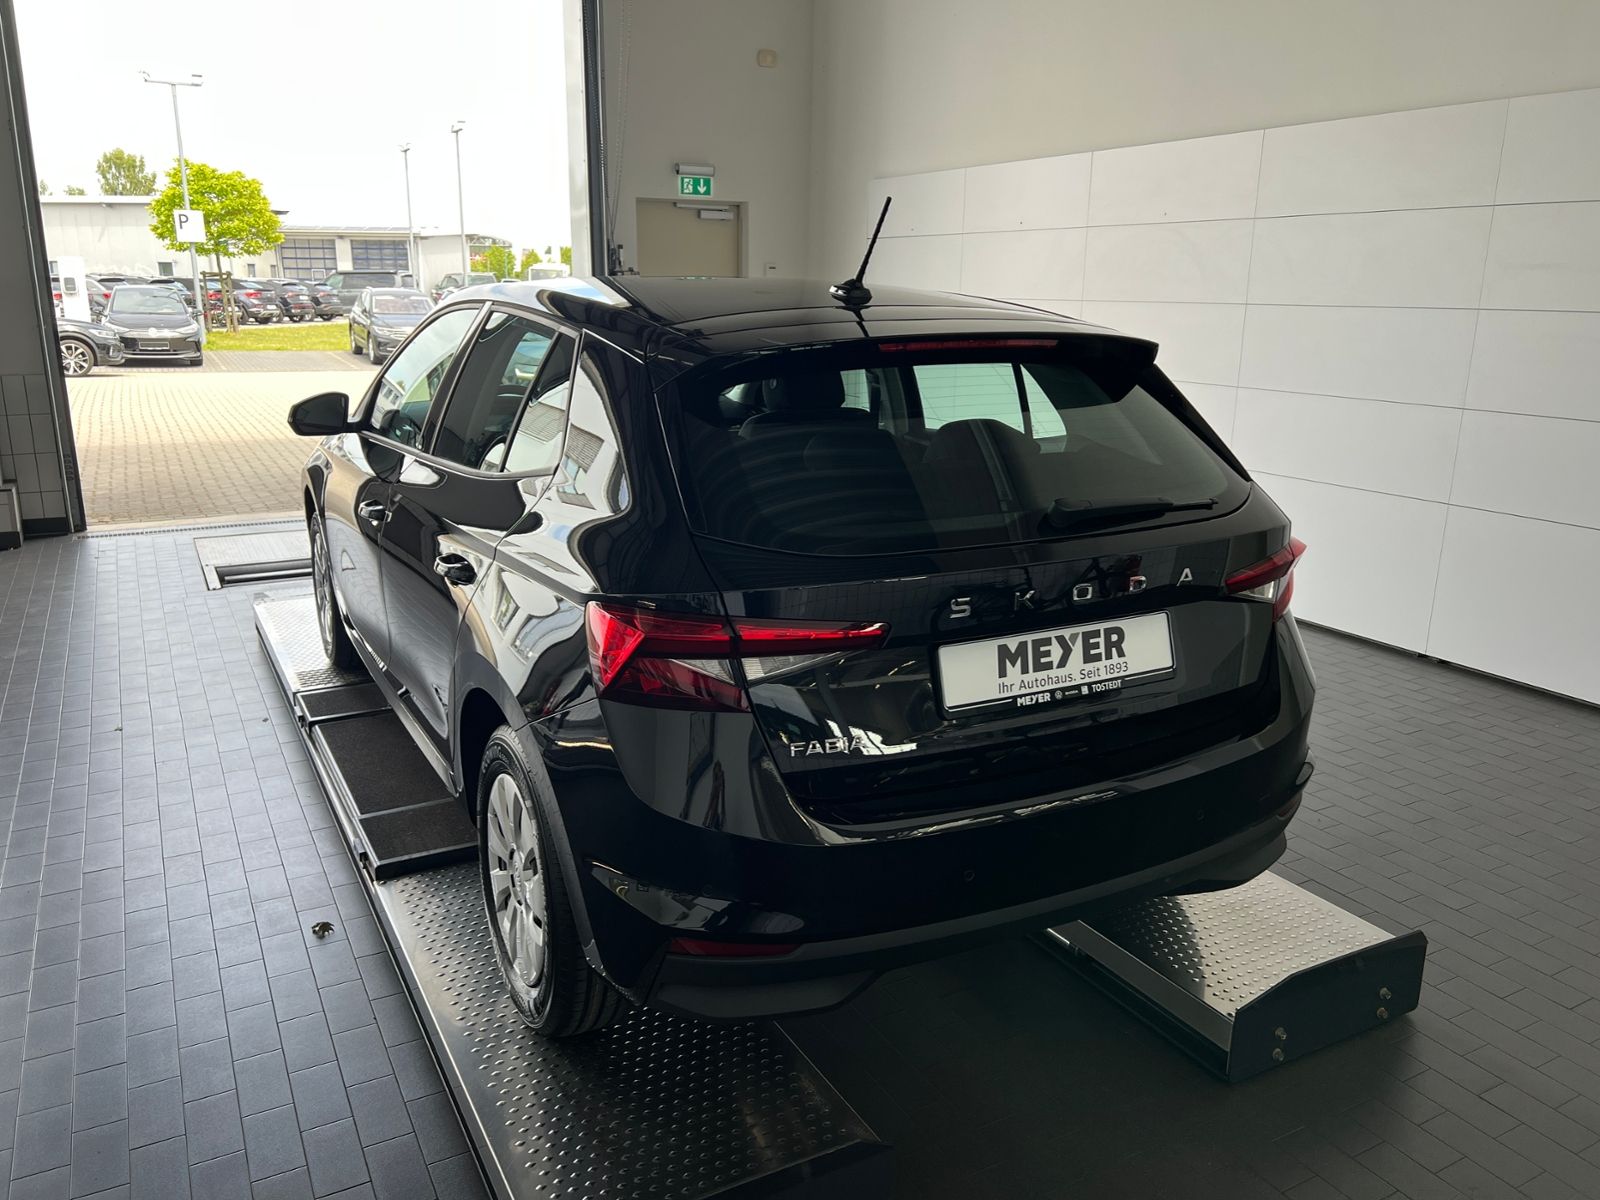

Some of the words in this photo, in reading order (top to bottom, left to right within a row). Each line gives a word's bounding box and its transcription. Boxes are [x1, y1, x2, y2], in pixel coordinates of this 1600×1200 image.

[178, 213, 189, 230] P
[949, 567, 1193, 619] SKODA
[997, 625, 1127, 679] MEYER
[998, 681, 1015, 695] Ihr
[1018, 673, 1077, 691] Autohaus.
[1079, 666, 1102, 680] Seit
[1104, 661, 1129, 676] 1893
[1016, 692, 1051, 707] MEYER
[1091, 679, 1122, 693] TOSTEDT
[790, 736, 867, 757] FABIA
